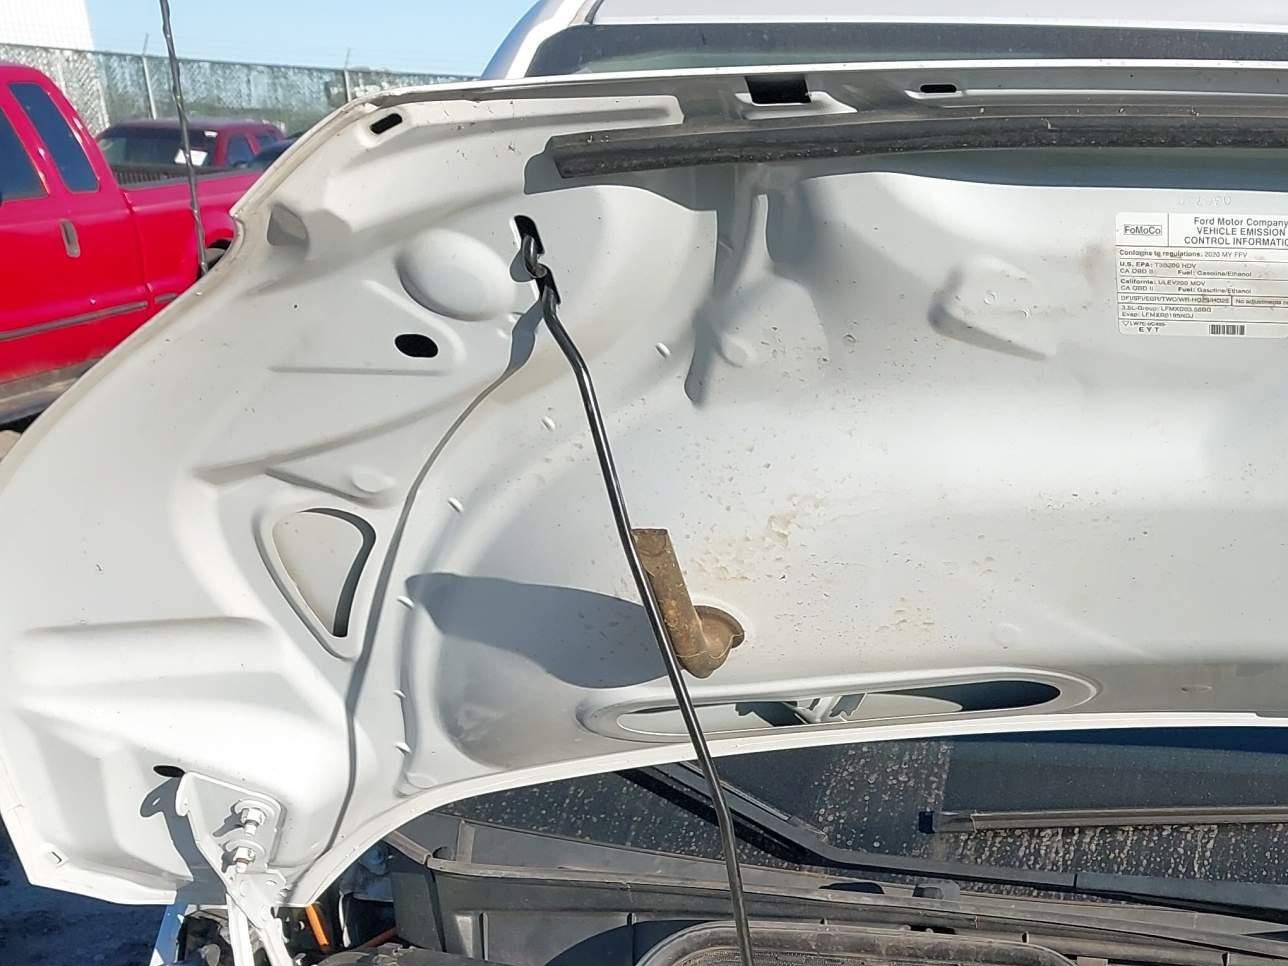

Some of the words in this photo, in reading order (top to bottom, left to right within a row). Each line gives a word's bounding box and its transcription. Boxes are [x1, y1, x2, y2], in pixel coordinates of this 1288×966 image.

[1194, 217, 1215, 226] Ford
[1217, 217, 1243, 226] Motor
[1246, 218, 1288, 229] Company
[1124, 226, 1162, 236] FoMoCo
[1197, 226, 1237, 236] VEHICLE
[1240, 227, 1286, 237] EMISSION
[1184, 236, 1230, 245] CONTROL
